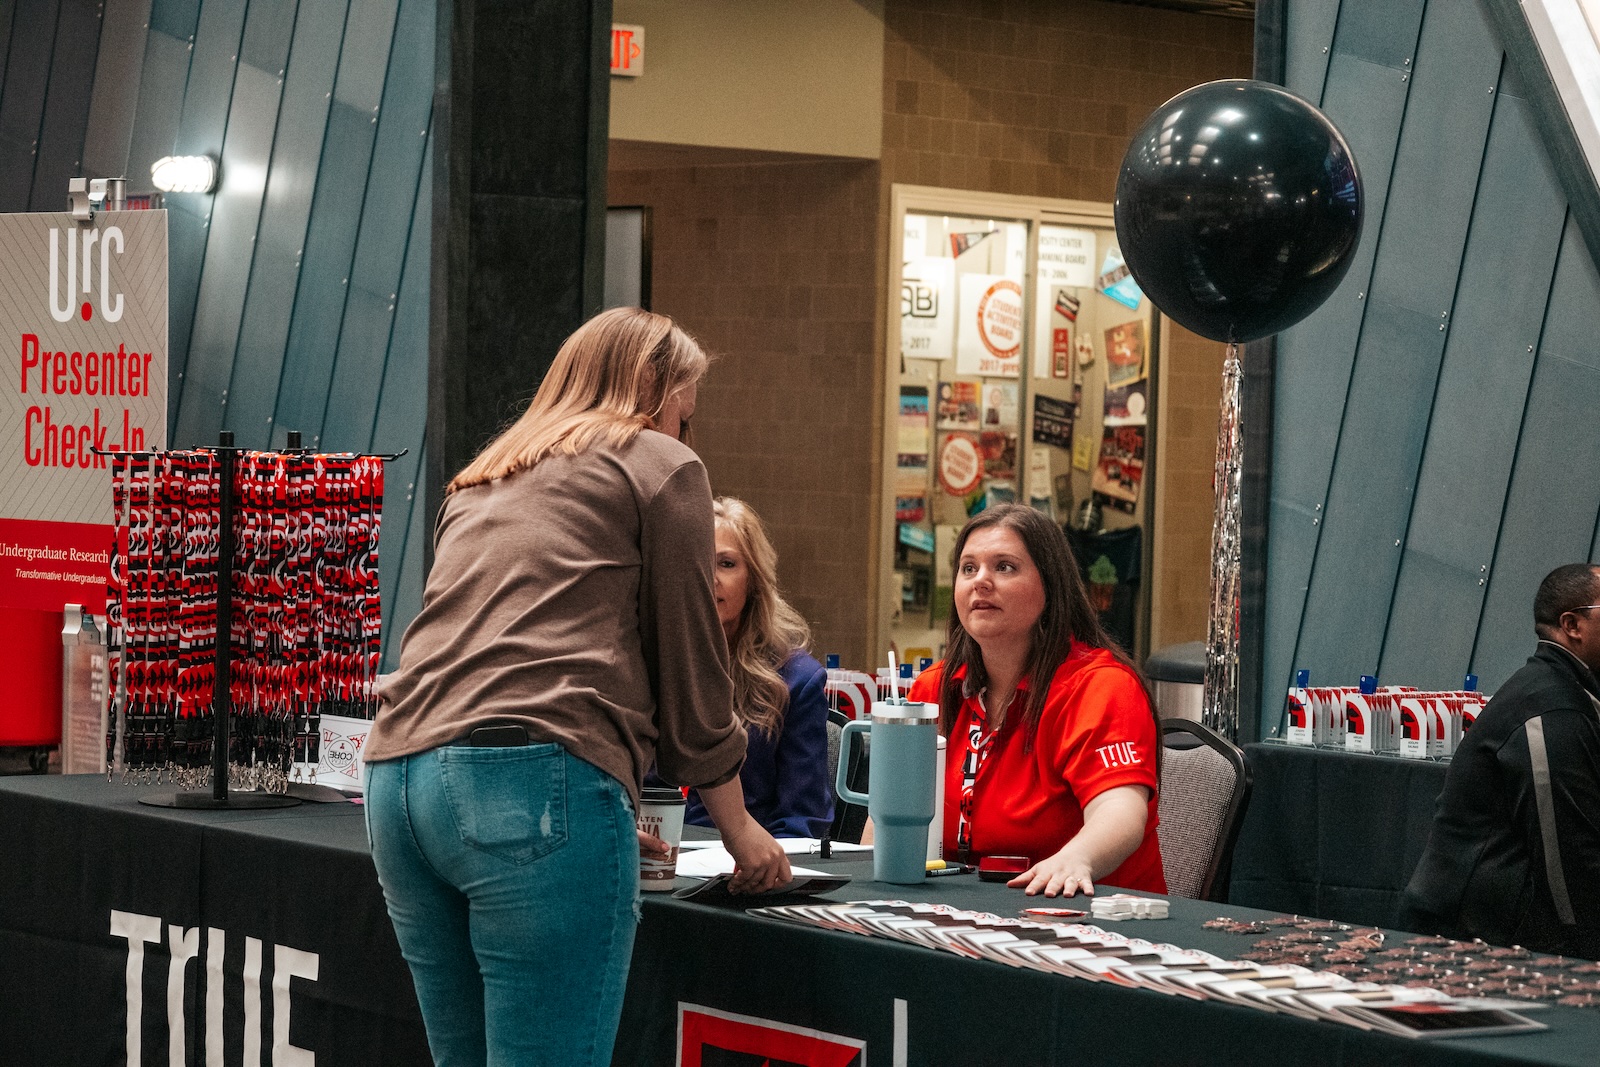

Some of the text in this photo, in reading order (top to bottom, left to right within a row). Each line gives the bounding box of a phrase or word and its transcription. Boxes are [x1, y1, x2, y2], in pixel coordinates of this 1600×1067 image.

[610, 30, 634, 69] IT
[910, 336, 931, 349] 2017
[21, 333, 152, 397] Presenter
[25, 405, 144, 470] Check-In
[0, 543, 67, 561] Undergraduate
[69, 547, 109, 564] Research
[15, 568, 62, 581] Transformative
[62, 571, 107, 585] Undergraduate
[329, 750, 353, 761] CORE
[637, 824, 660, 839] VA
